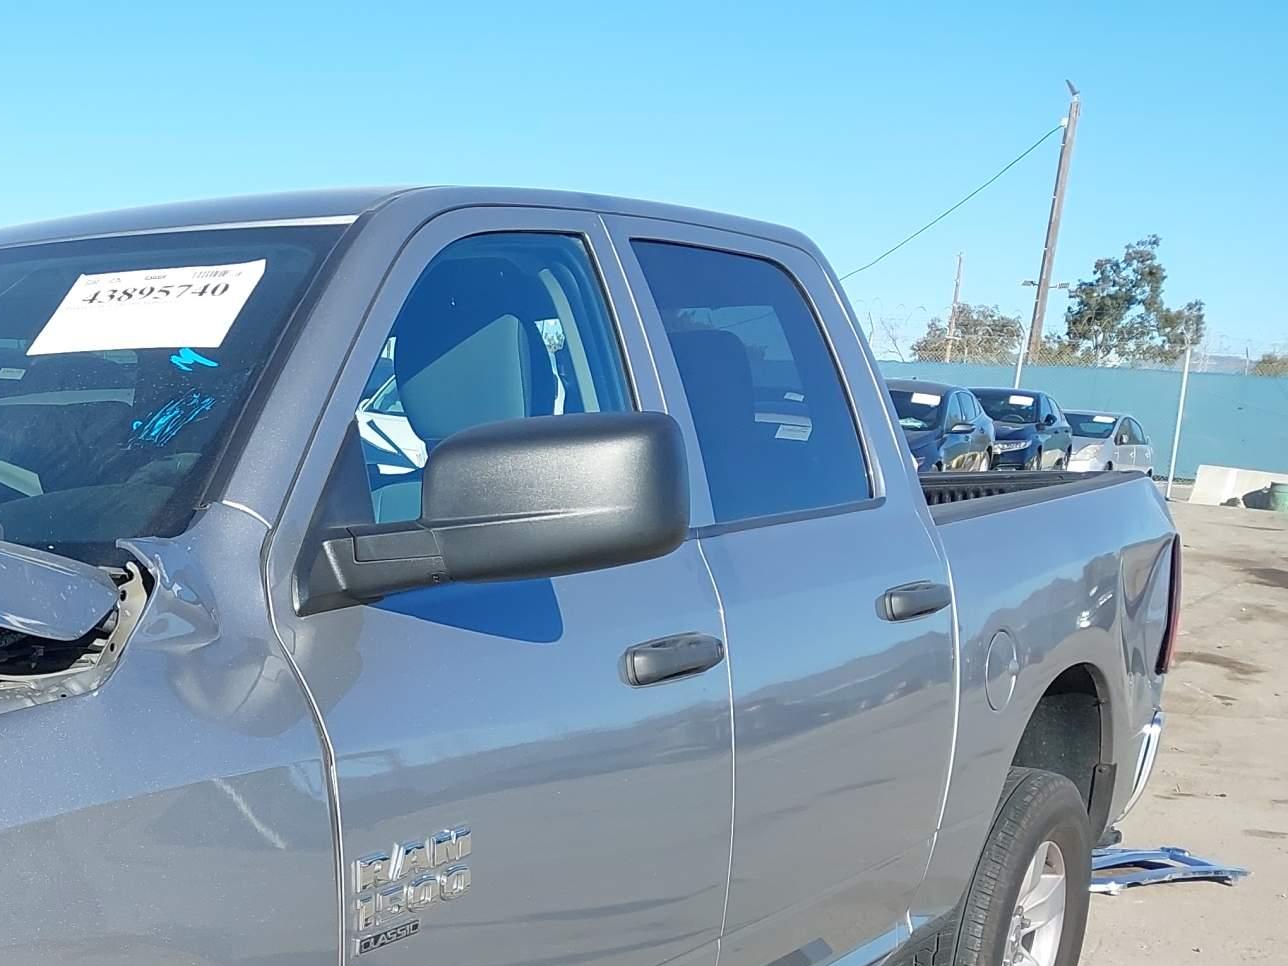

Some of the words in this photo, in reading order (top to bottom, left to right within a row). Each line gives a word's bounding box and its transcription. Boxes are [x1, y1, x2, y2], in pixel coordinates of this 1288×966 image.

[81, 282, 231, 304] 43895740
[352, 825, 472, 893] RAM
[353, 863, 472, 931] 1500
[360, 921, 419, 951] CLASSIC
